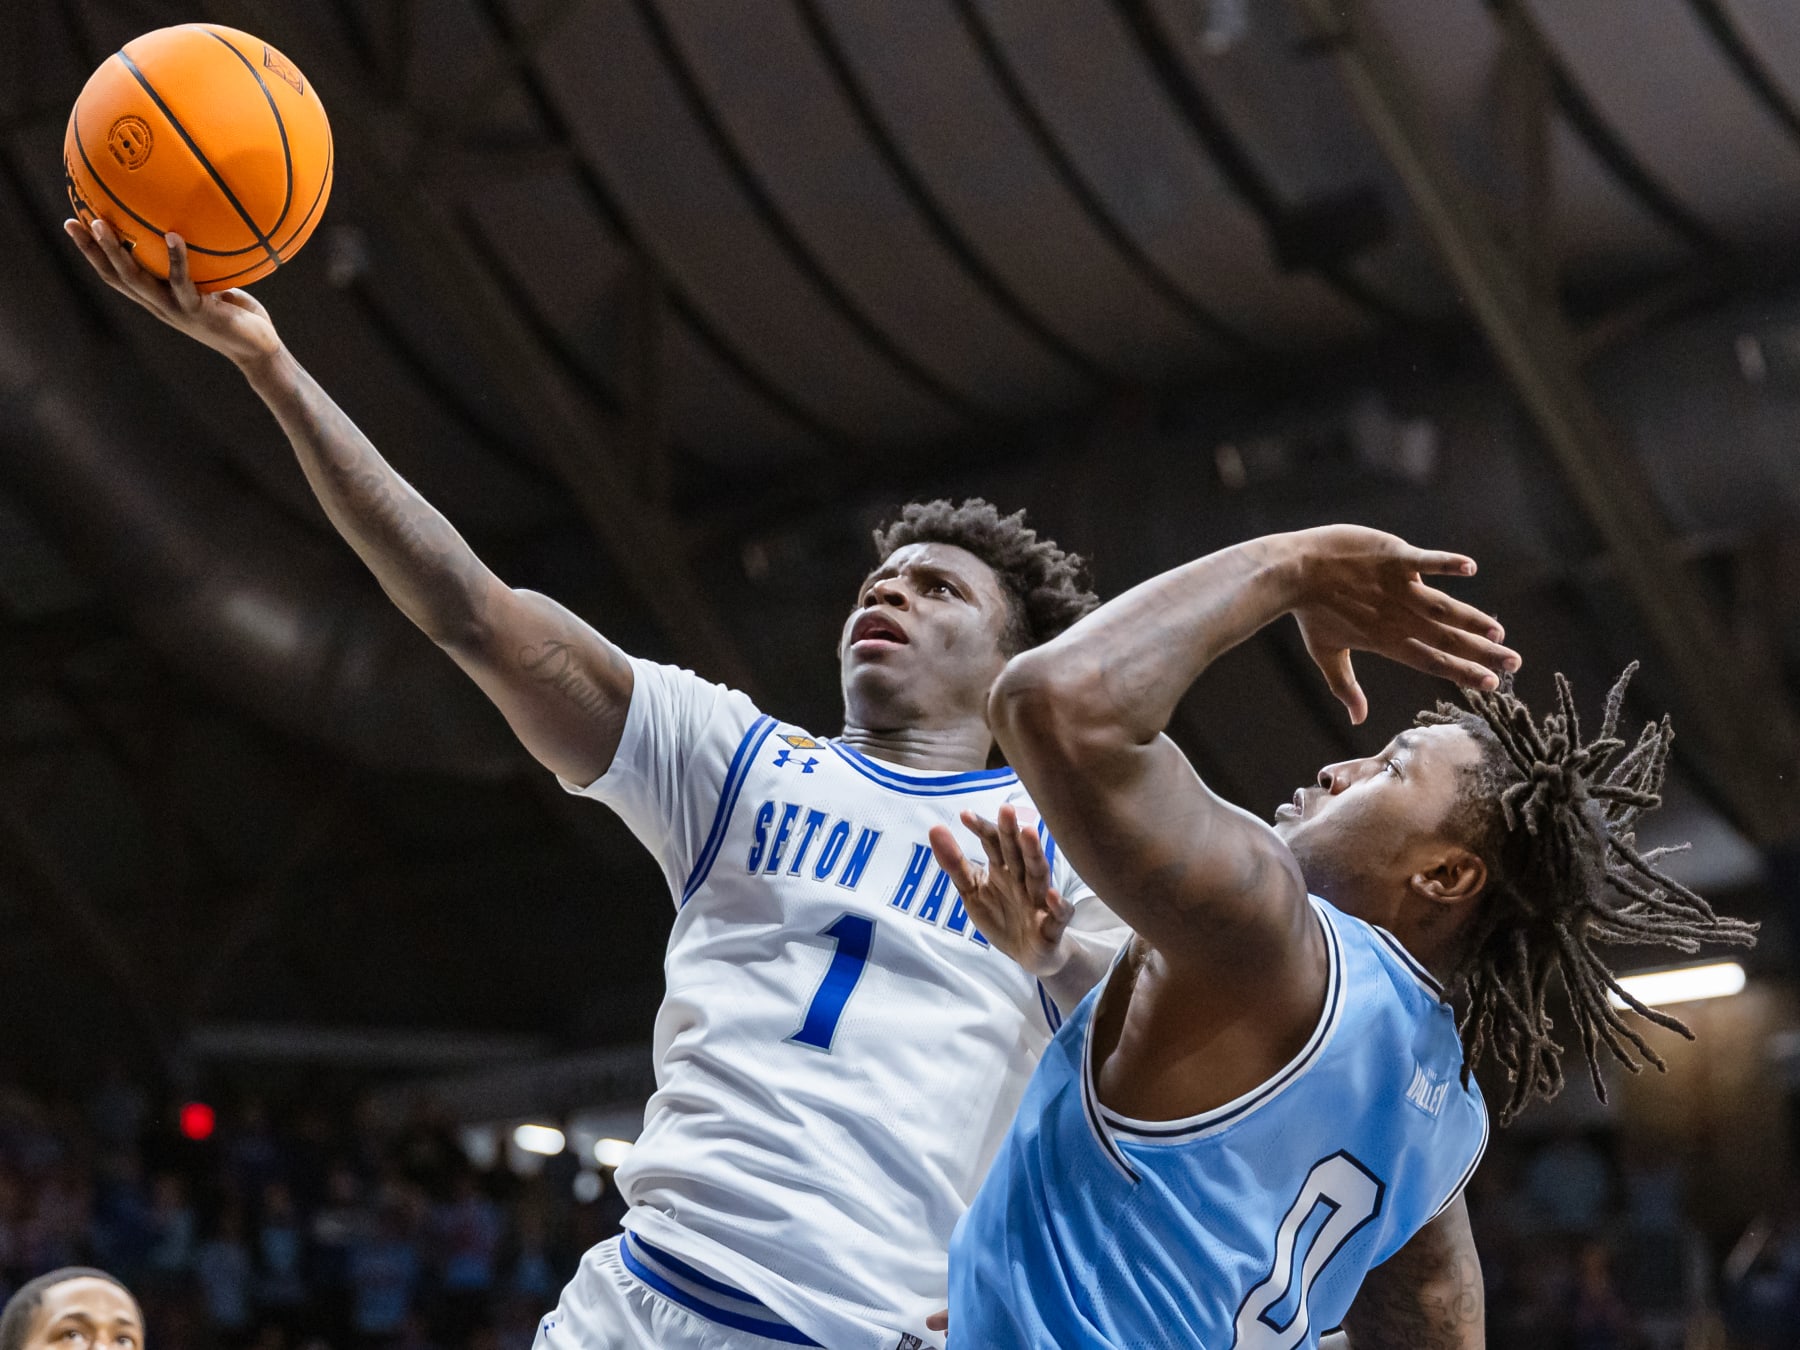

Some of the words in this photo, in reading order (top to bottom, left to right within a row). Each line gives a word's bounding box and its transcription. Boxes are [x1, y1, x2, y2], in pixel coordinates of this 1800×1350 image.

[747, 800, 883, 890] SETON
[887, 843, 991, 949] HAL
[782, 912, 877, 1055] 1
[1405, 1060, 1450, 1117] VALLEY
[1231, 1149, 1386, 1350] 0
